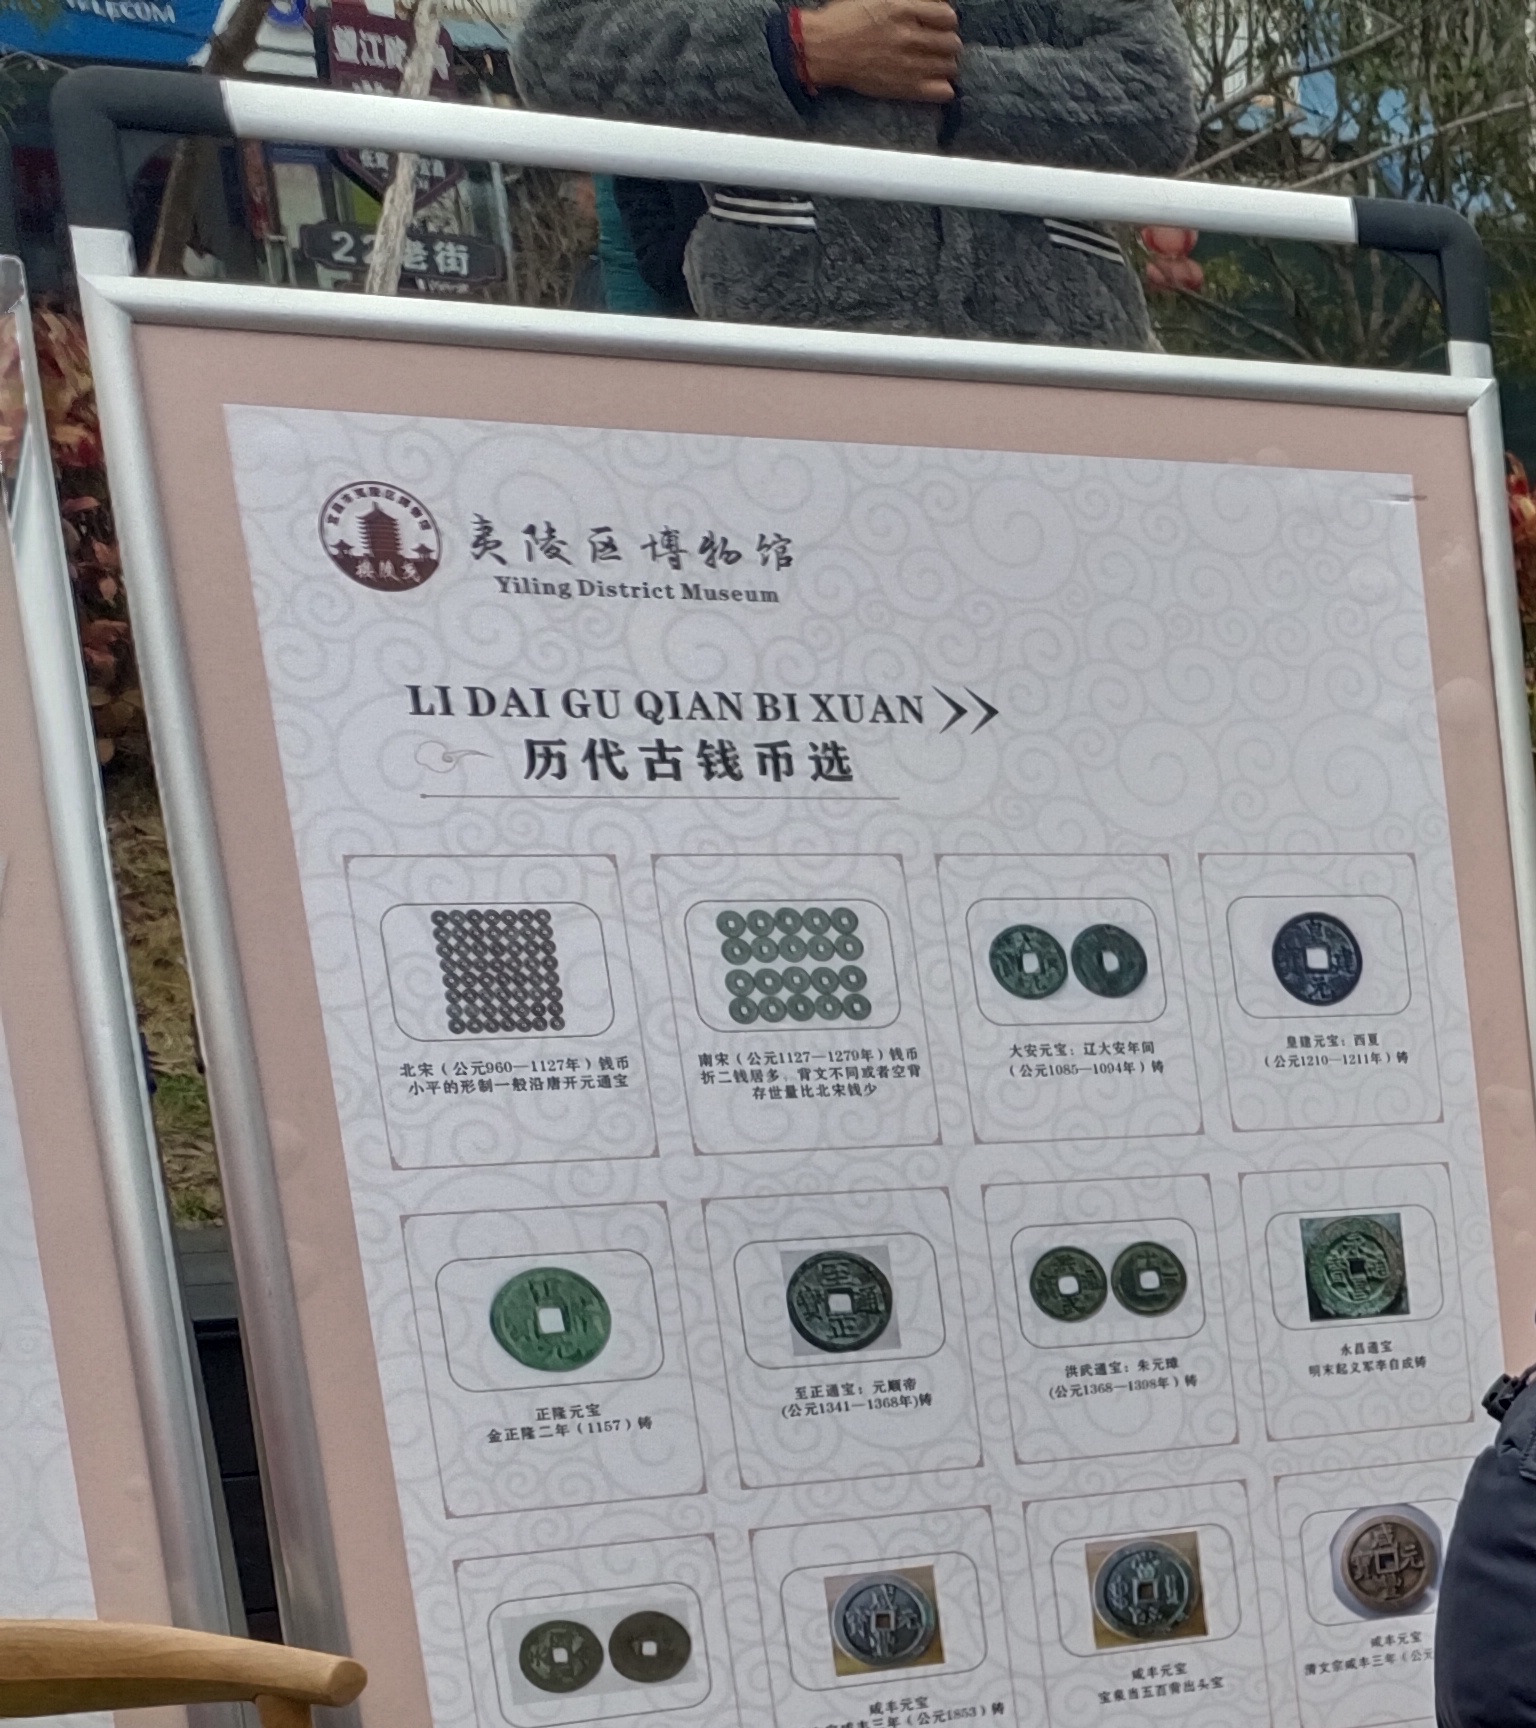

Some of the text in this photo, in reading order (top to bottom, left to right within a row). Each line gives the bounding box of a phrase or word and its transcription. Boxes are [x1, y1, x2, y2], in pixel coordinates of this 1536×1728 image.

[469, 512, 796, 574] 夷陵区博物馆
[495, 575, 780, 604] Yiling District Museum
[407, 685, 924, 726] LI DAI GU QIAN BI XUAN
[523, 739, 855, 784] 历代古钱币选
[1286, 1033, 1380, 1049] 皇建元宝：西夏
[408, 1074, 629, 1096] 小平的形制一般沿唐开元通宝
[752, 1082, 878, 1100] 存世量比北宋钱少
[1340, 1340, 1393, 1356] 永昌通宝
[1065, 1357, 1179, 1379] 洪武通宝：朱元璋
[794, 1378, 917, 1400] 至正通宝：元顺帝
[536, 1404, 602, 1421] 正隆元宝
[1370, 1631, 1422, 1648] 咸丰元宝
[1131, 1662, 1187, 1681] 咸丰元宝
[869, 1696, 929, 1716] 咸丰元宝
